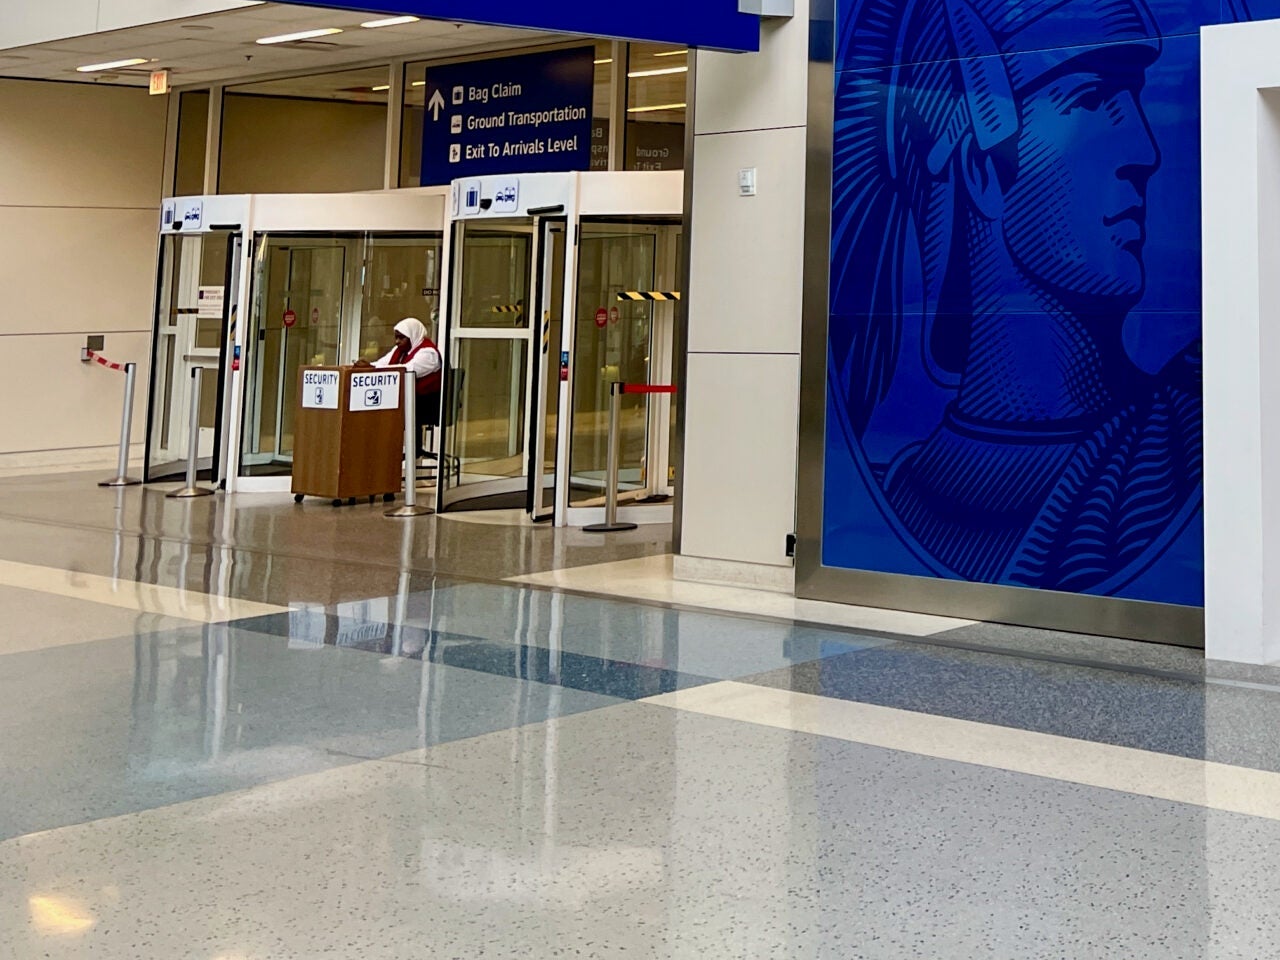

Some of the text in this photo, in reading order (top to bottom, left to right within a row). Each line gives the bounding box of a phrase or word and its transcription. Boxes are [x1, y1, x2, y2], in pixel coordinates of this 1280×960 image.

[468, 82, 522, 103] Bag Claim
[467, 105, 587, 130] Ground Transportation
[465, 143, 485, 160] Exit
[488, 142, 500, 158] To
[502, 138, 545, 157] Arrivals
[547, 135, 578, 153] Level
[304, 373, 338, 385] SECURITY
[352, 374, 399, 388] SECURITY
